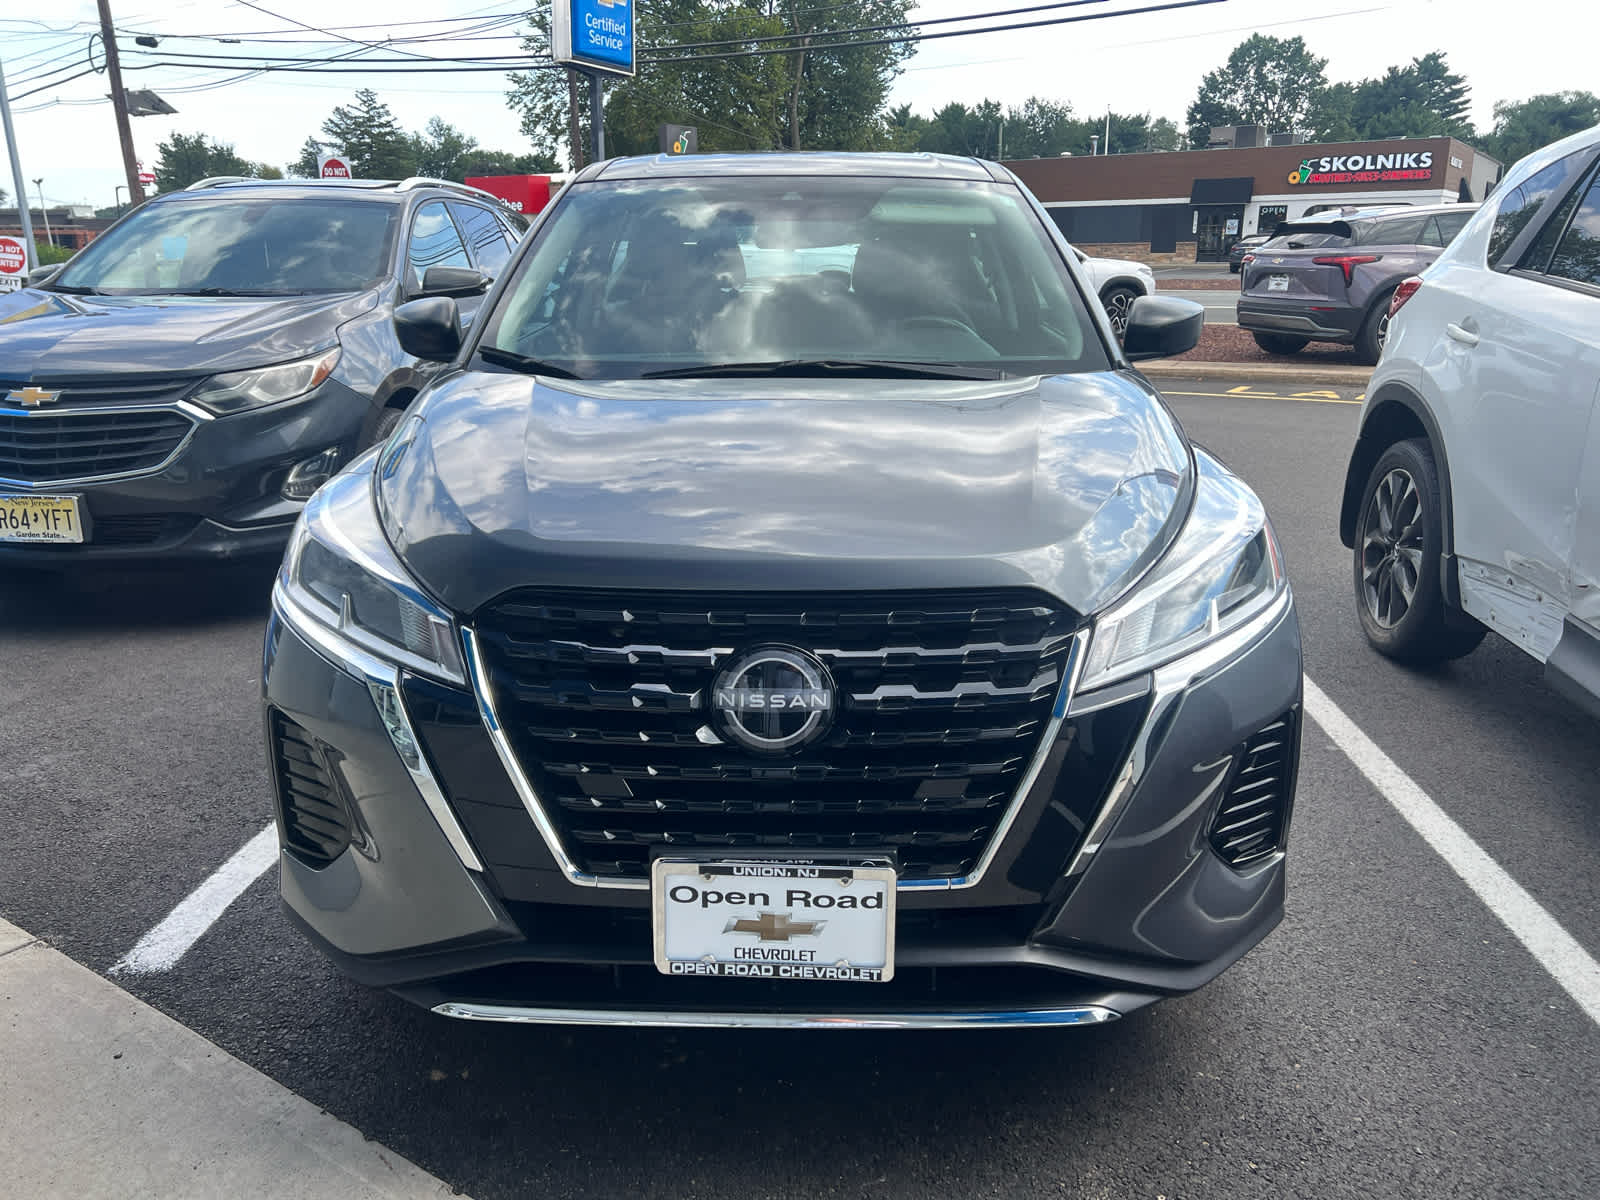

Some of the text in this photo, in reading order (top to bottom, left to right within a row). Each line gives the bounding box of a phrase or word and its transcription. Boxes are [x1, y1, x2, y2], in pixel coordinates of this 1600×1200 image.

[585, 12, 626, 37] Certified
[588, 29, 623, 50] Service
[1318, 152, 1433, 173] SKOLNIKS
[324, 167, 346, 177] DO NOT
[5, 245, 20, 254] NOT
[0, 259, 20, 268] NTER
[719, 692, 827, 708] NISSAN
[797, 868, 819, 878] NJ
[669, 886, 883, 909] Open Road
[734, 947, 817, 962] CHEVROLET
[671, 962, 881, 981] OPEN ROAD CHEVROLET
